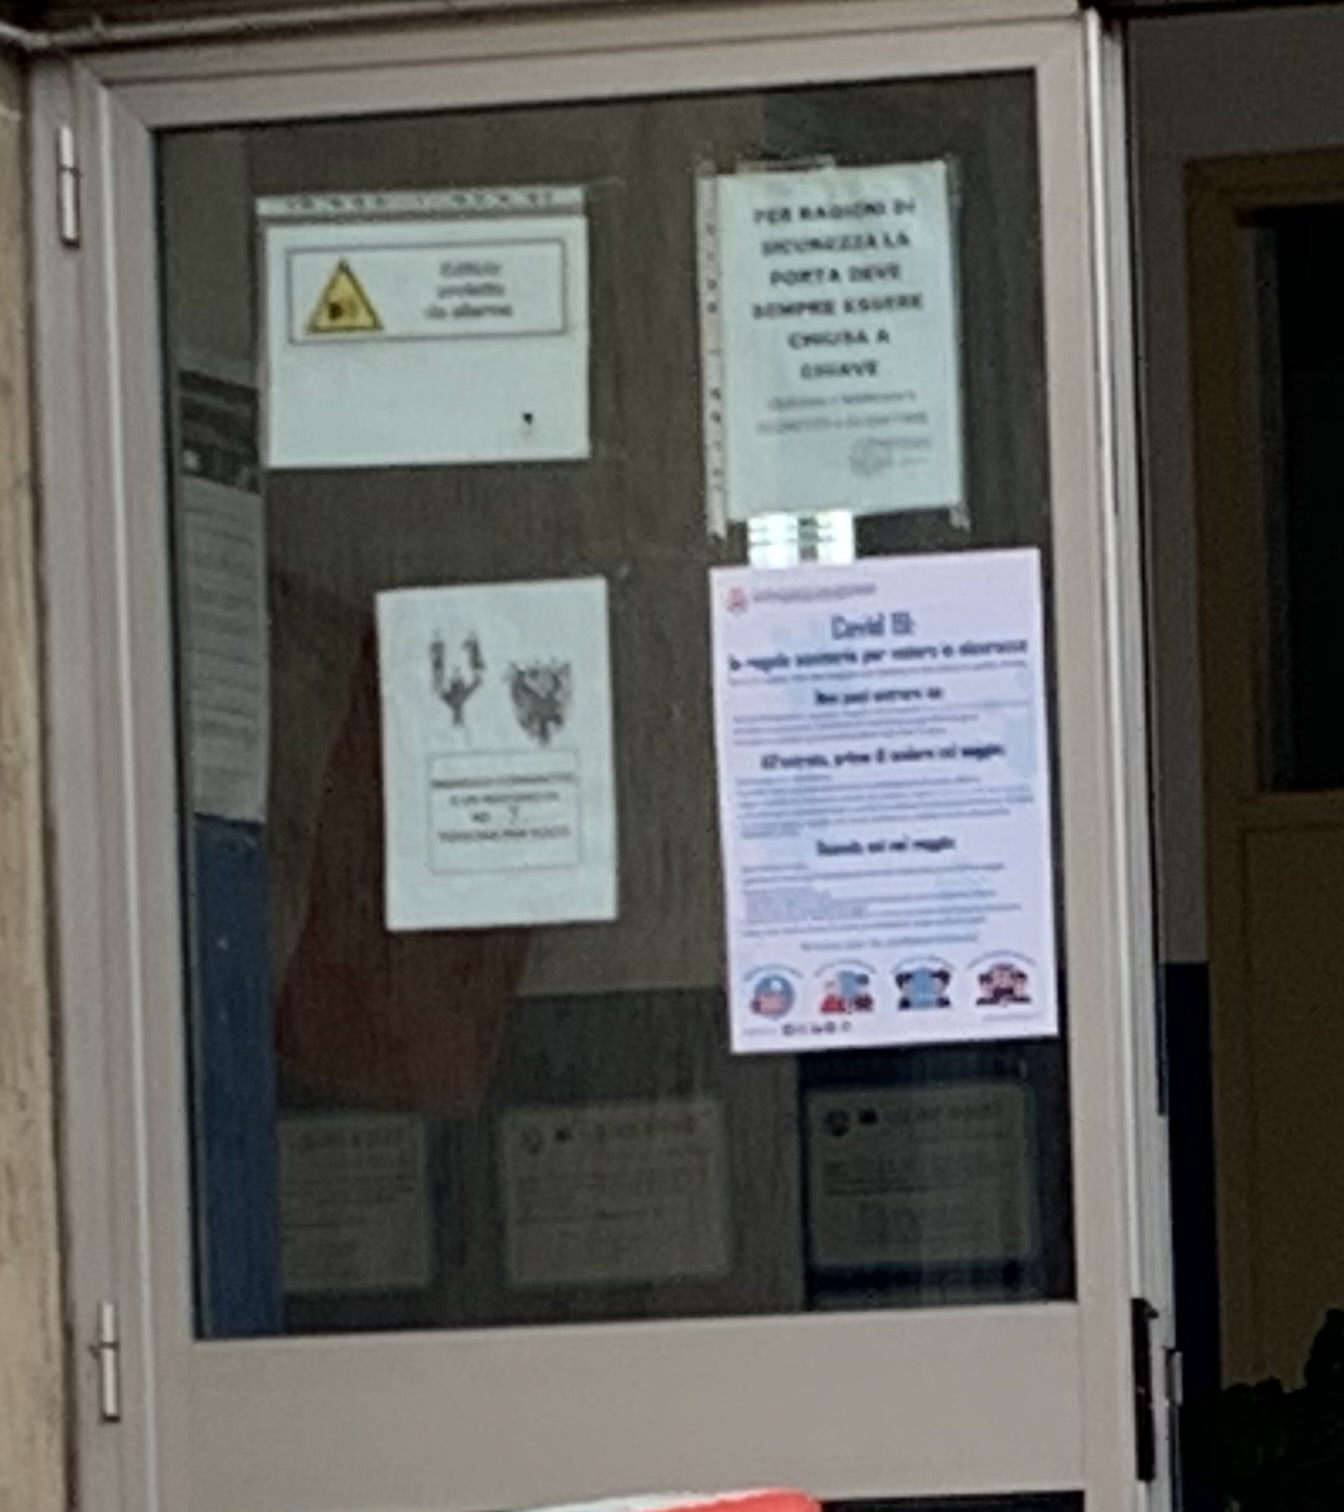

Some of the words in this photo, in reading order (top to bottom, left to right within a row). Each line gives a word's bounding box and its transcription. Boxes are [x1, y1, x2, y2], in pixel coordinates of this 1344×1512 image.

[754, 206, 791, 225] PER
[798, 201, 886, 221] RAGIONI
[892, 199, 916, 216] DI
[760, 233, 876, 256] SICUREZZA
[882, 231, 910, 249] LA
[769, 267, 840, 286] PORTA
[847, 263, 900, 283] DEVE
[752, 300, 834, 320] SEMPRE
[843, 293, 923, 314] ESSERE
[787, 329, 870, 350] CHIUSA
[876, 328, 890, 344] A
[800, 359, 878, 379] CHIAVE
[830, 613, 885, 640] Covid
